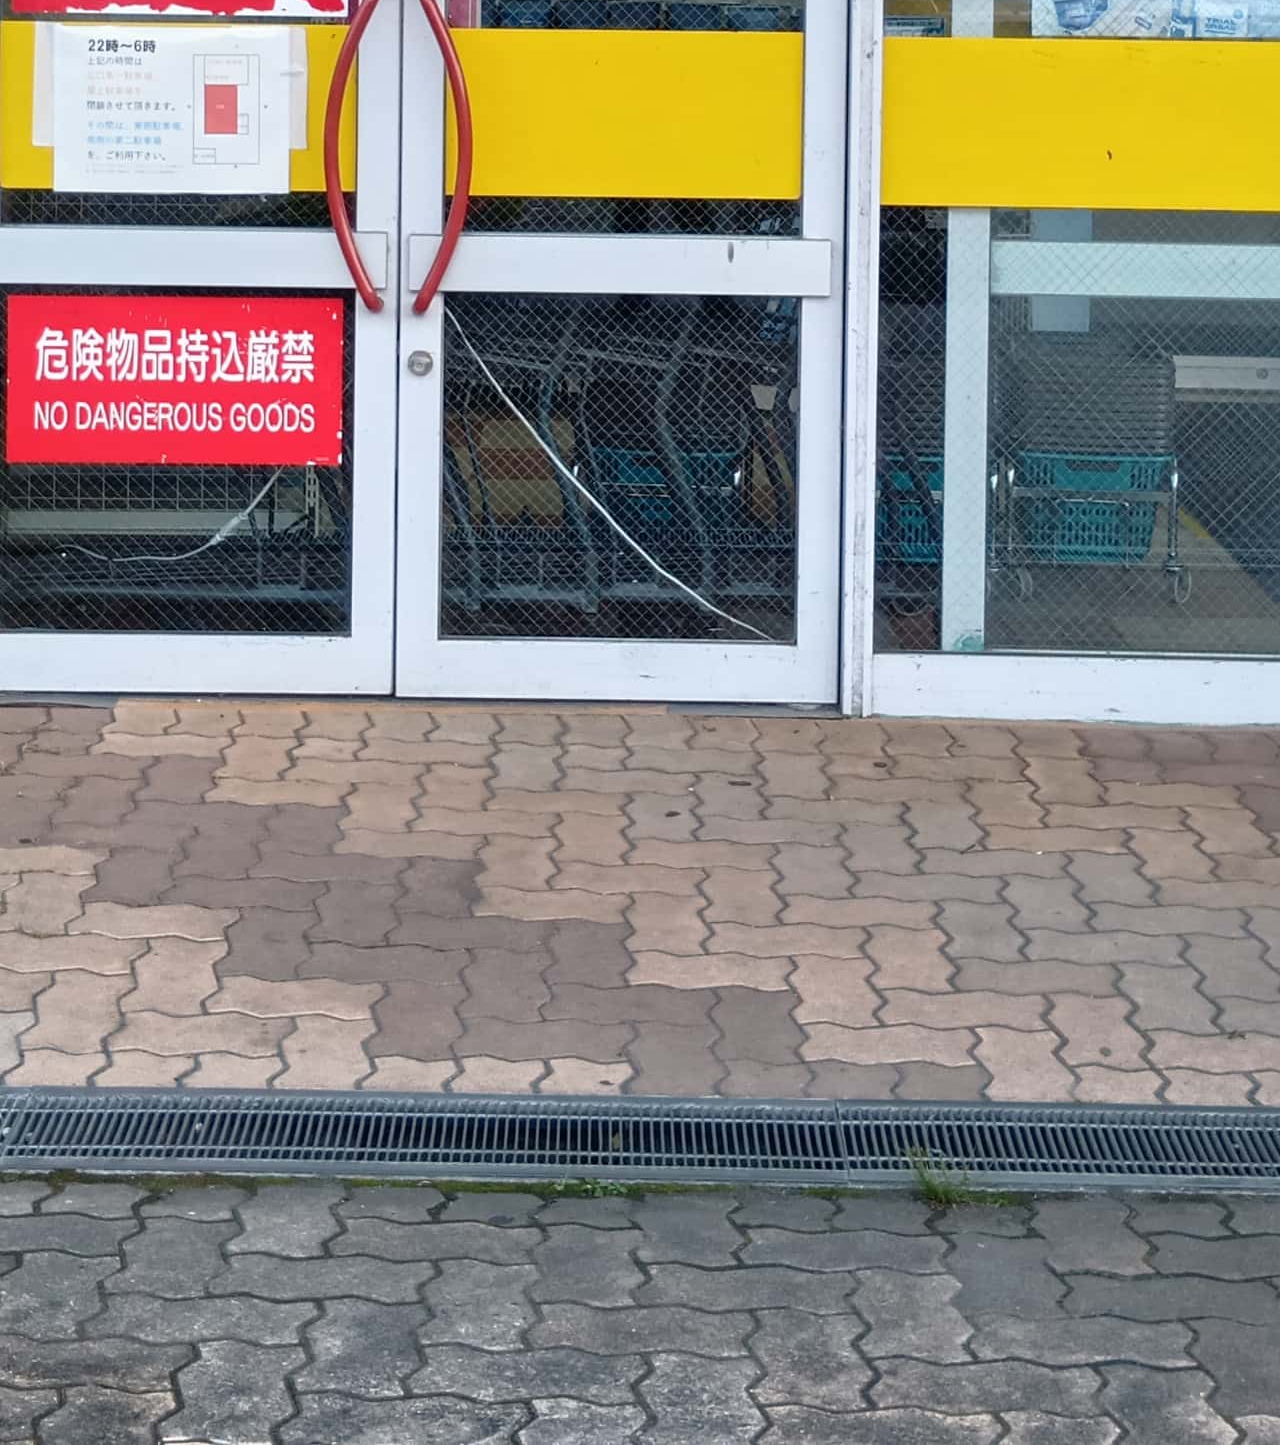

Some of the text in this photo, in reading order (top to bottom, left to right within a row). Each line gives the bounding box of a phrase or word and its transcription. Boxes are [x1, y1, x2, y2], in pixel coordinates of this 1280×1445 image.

[34, 328, 316, 384] 危険物品持込厳禁
[33, 400, 316, 433] NO DANGEROUS GOODS
